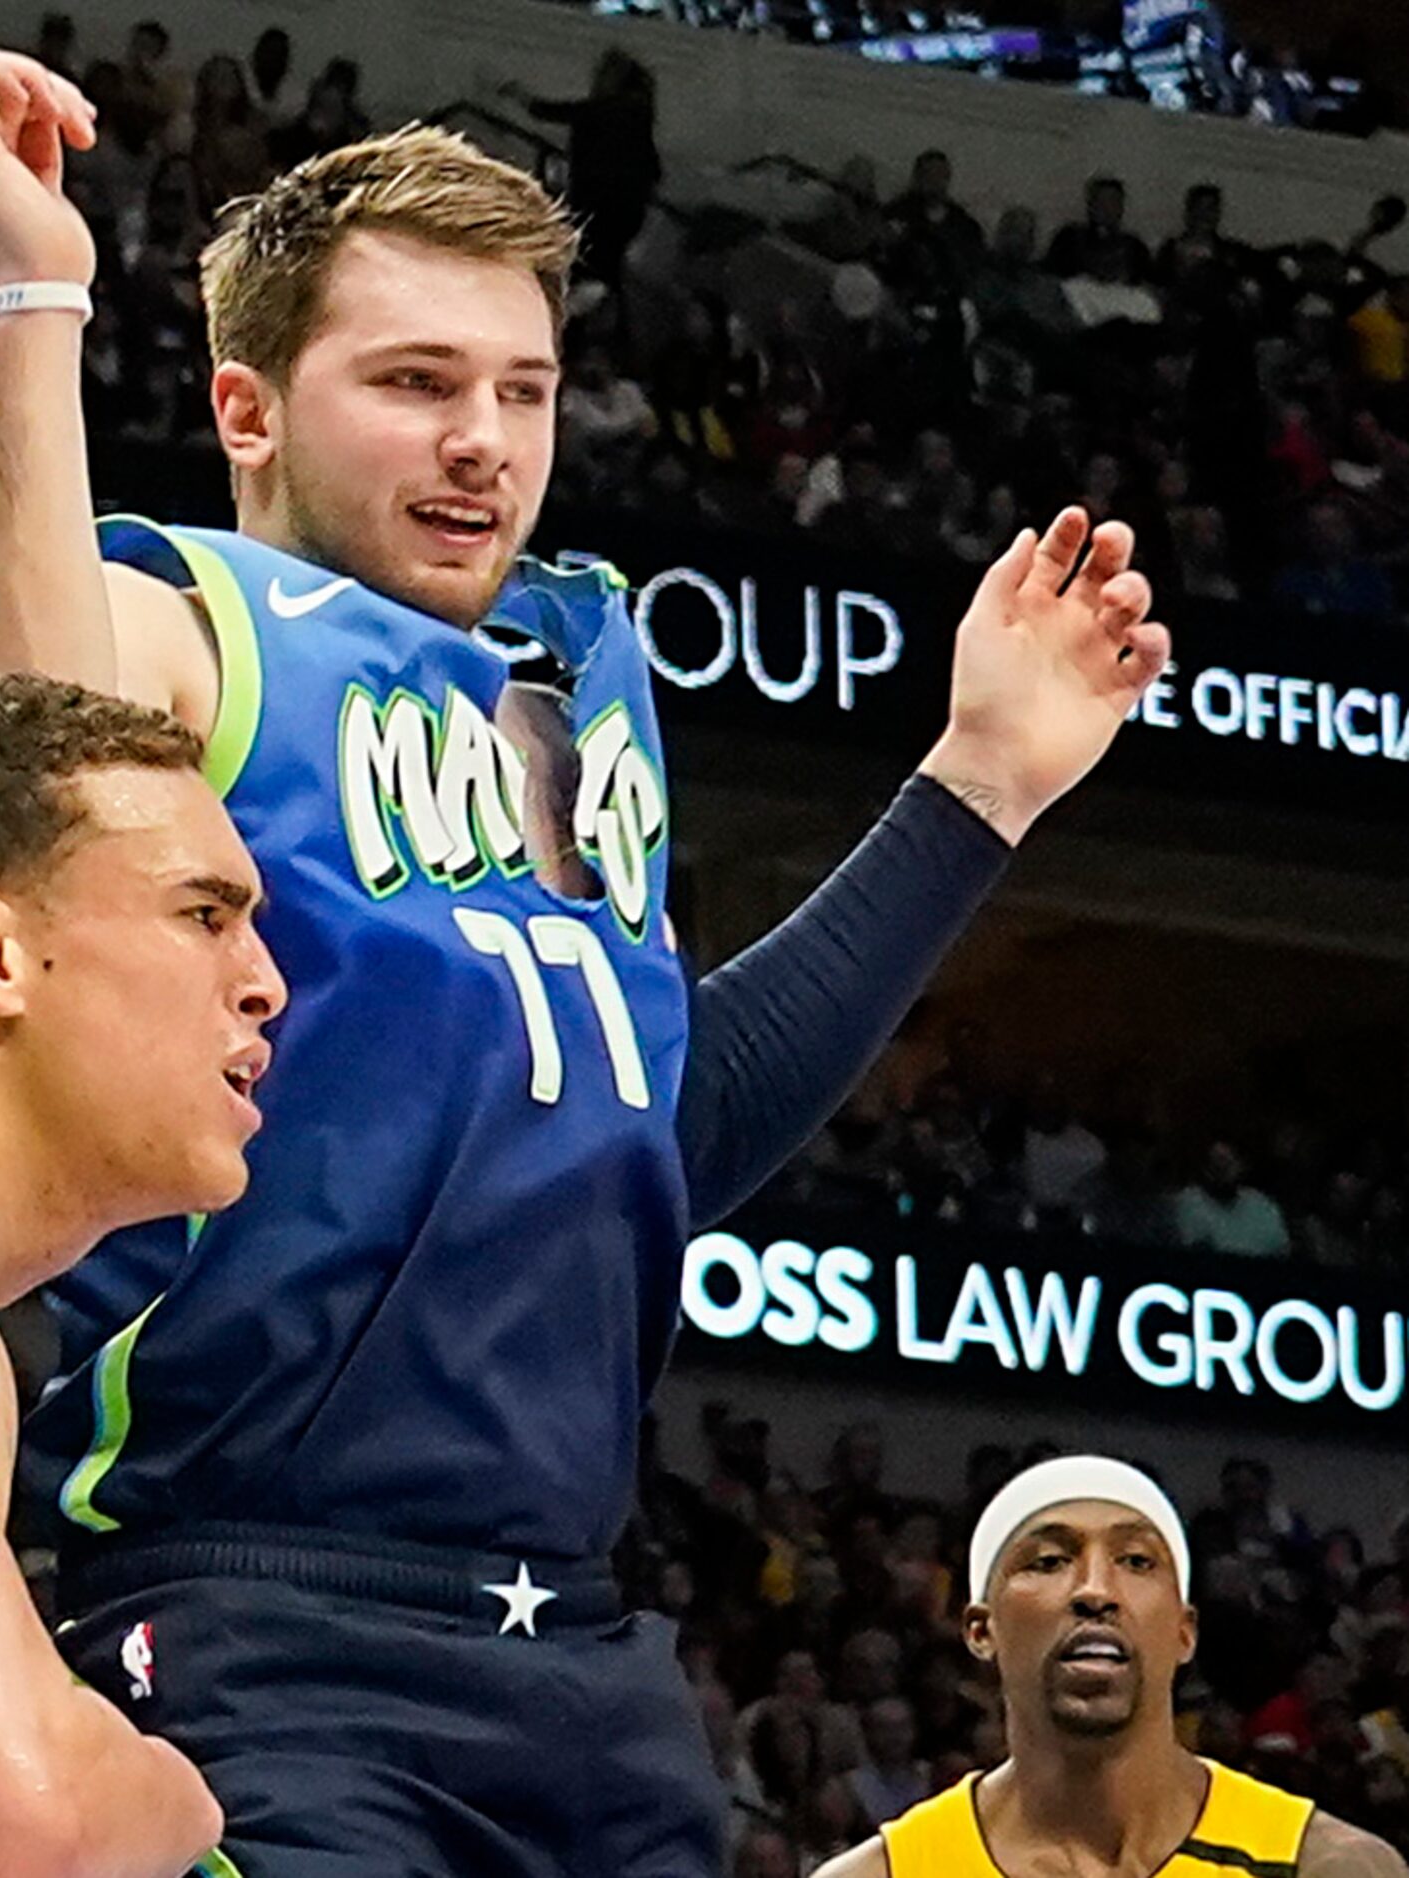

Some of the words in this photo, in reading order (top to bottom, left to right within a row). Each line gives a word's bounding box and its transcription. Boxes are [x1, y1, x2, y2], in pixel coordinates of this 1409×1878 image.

[1191, 666, 1409, 762] OFFICI
[452, 907, 651, 1110] 77
[680, 1231, 879, 1353] OSS
[894, 1254, 1102, 1376] LAW
[1117, 1282, 1407, 1412] GROU
